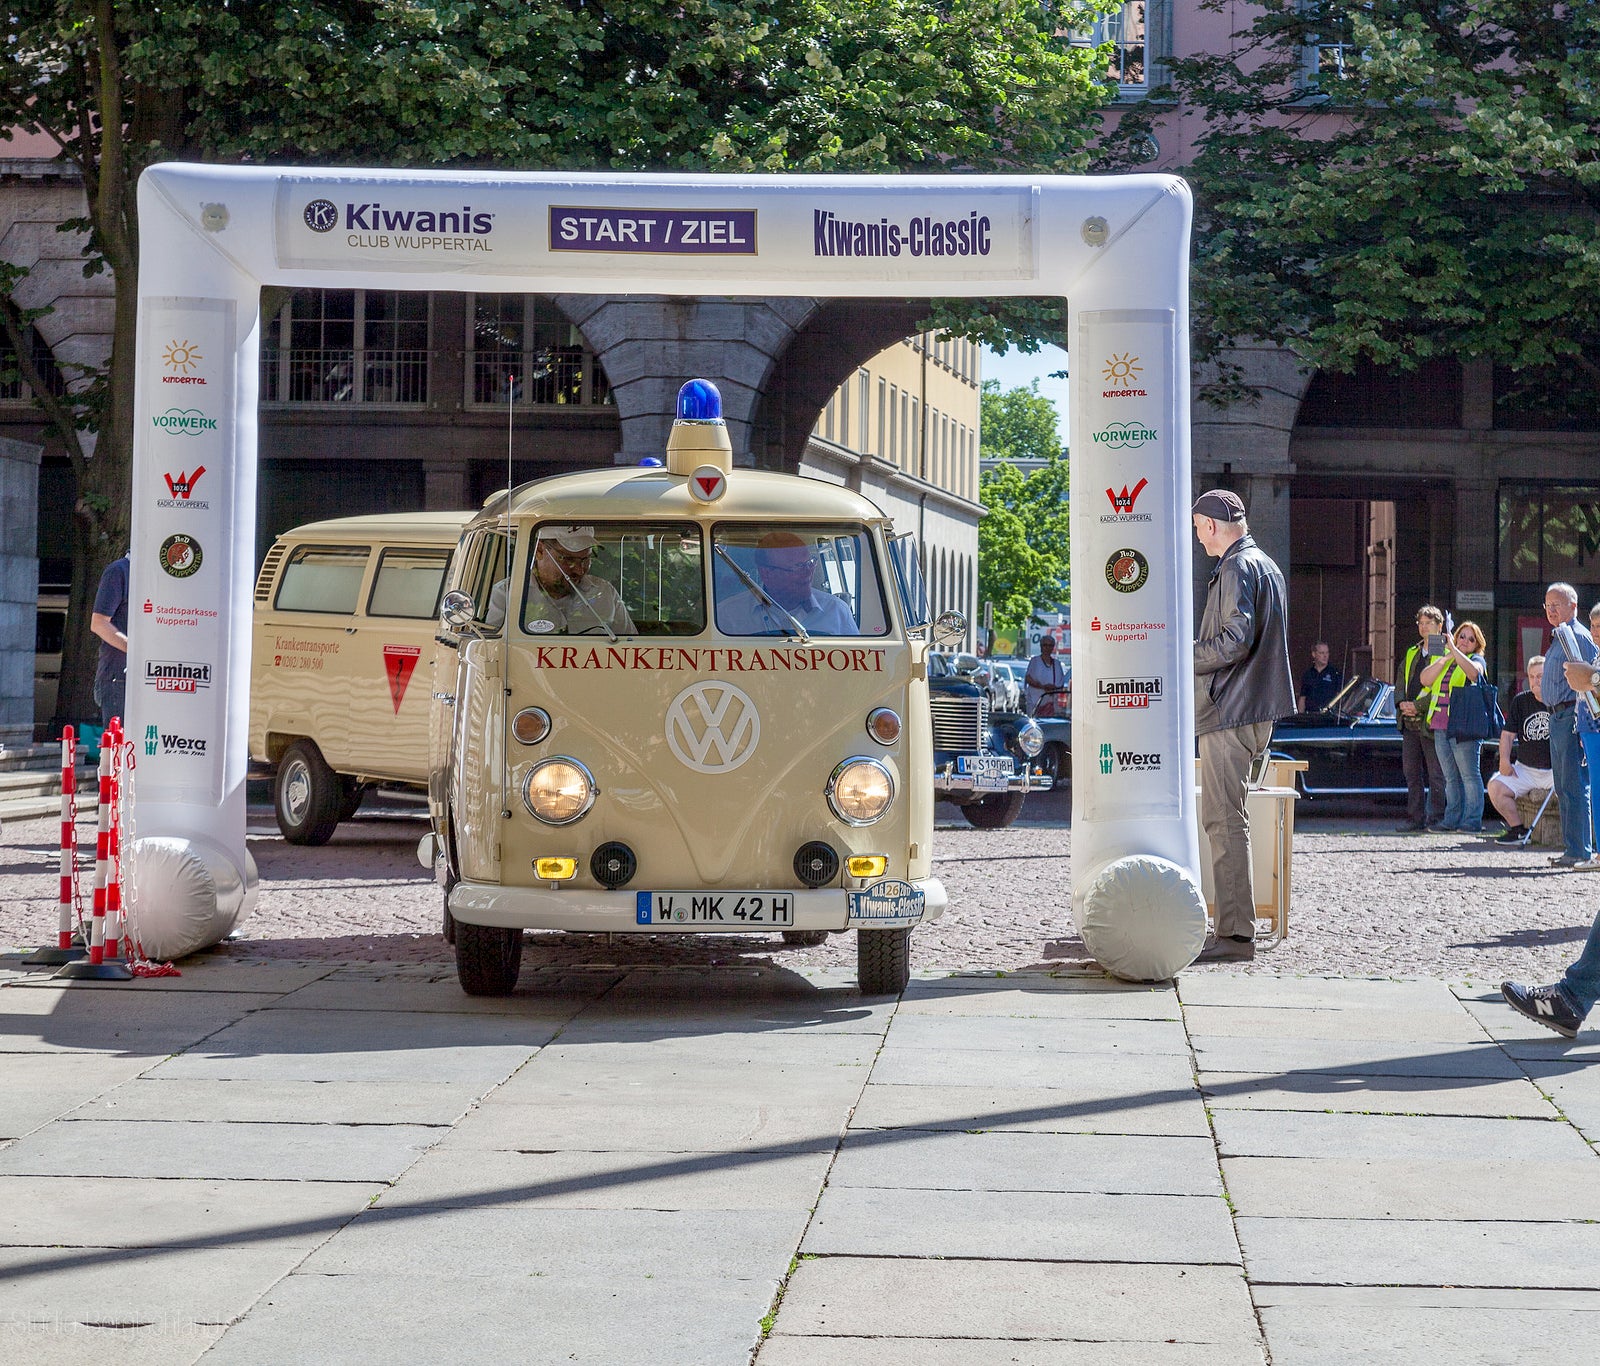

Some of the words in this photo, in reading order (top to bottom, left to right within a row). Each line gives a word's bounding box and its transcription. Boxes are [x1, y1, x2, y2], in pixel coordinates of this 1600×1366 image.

[346, 203, 494, 235] Kiwanis
[559, 216, 657, 243] START
[664, 219, 673, 244] /
[680, 219, 746, 245] ZIEL
[813, 208, 991, 257] Kiwanis-Classic
[347, 234, 390, 249] CLUB
[395, 235, 493, 252] WUPPERTAL
[152, 416, 218, 430] VORWERK
[1092, 429, 1158, 443] VORWERK
[157, 499, 174, 508] RADIO
[176, 500, 210, 510] WUPPERTAL
[1100, 514, 1118, 523] RADIO
[1119, 513, 1152, 522] WUPPERTAL
[156, 605, 218, 618] Stadtsparkasse
[156, 617, 198, 627] Wuppertal
[1104, 622, 1166, 632] Stadtsparkasse
[1105, 632, 1148, 643] Wuppertal
[275, 636, 340, 656] Krankentransporte
[534, 646, 886, 672] KRANKENTRANSPORT
[147, 662, 209, 681] Laminat
[157, 679, 194, 691] DEPOT
[1098, 678, 1161, 695] Laminat
[1110, 695, 1147, 707] DEPOT
[161, 735, 207, 751] Wera
[965, 759, 972, 770] W
[1116, 751, 1161, 765] Wera
[885, 884, 899, 897] 26
[658, 896, 674, 920] W
[691, 896, 724, 921] MK
[733, 896, 764, 921] 42
[772, 897, 788, 922] H
[849, 893, 859, 918] 5.
[859, 892, 925, 918] Kiwanis-Classic
[1535, 998, 1555, 1016] N
